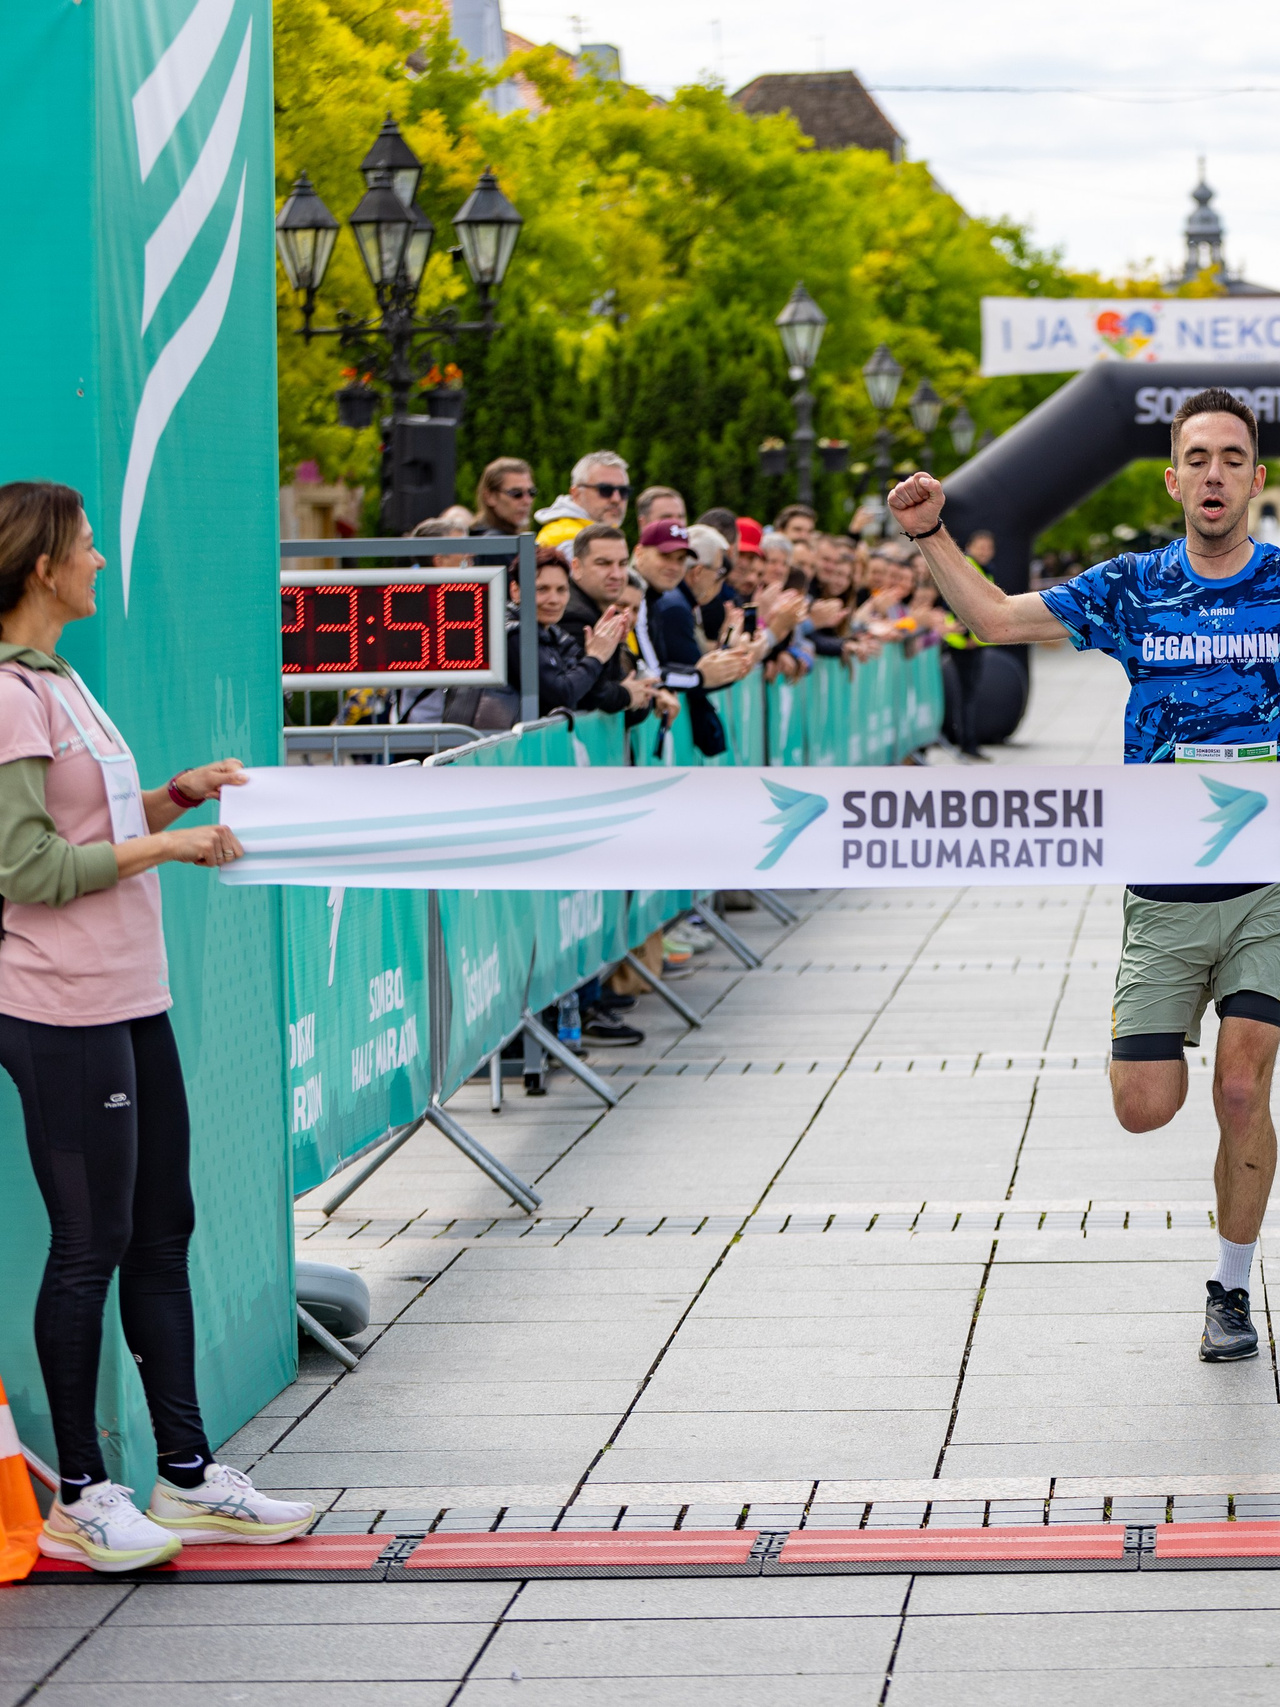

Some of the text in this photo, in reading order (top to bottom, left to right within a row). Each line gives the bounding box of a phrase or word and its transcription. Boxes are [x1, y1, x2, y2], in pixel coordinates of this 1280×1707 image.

[1001, 318, 1011, 351] I
[1027, 315, 1077, 350] JA
[842, 789, 1103, 828] SOMBORSKI
[842, 838, 1103, 869] POLUMARATON
